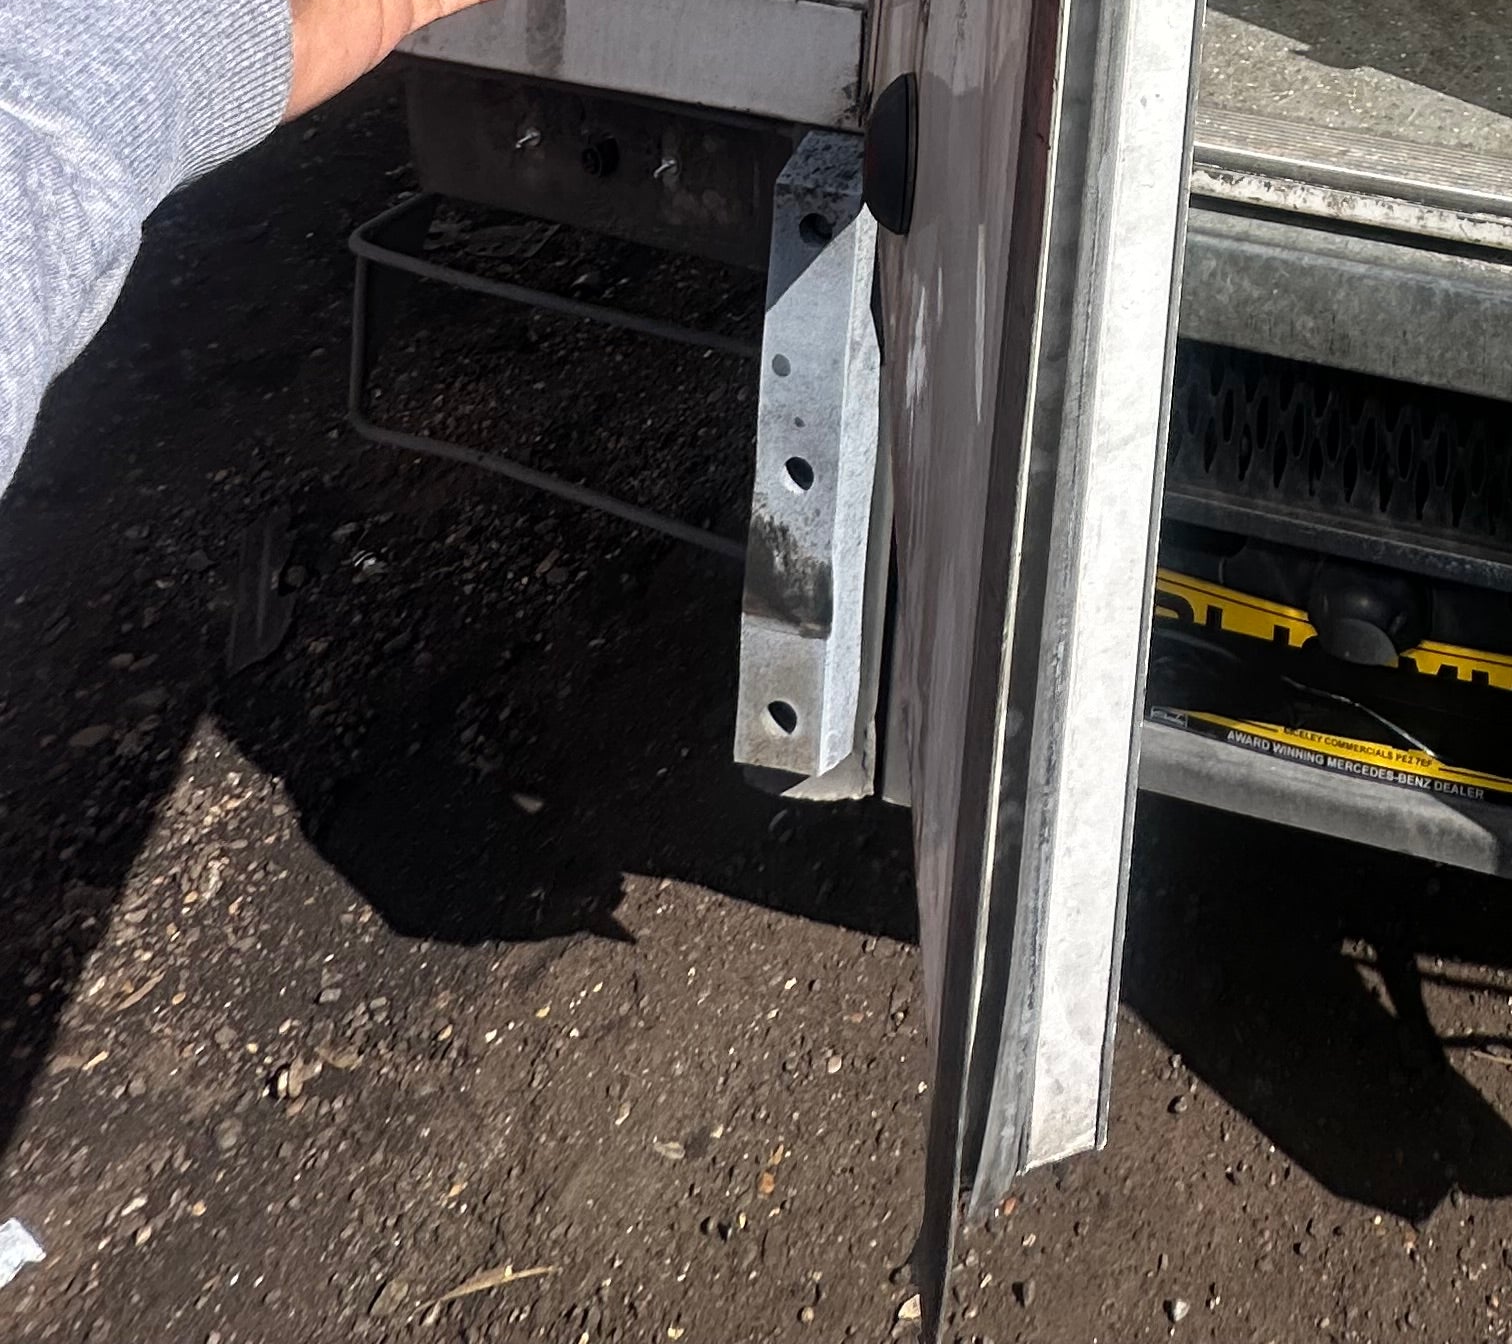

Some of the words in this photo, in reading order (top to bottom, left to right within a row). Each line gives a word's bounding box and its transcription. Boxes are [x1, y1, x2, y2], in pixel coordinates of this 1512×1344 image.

[1227, 729, 1270, 752] AWARD
[1272, 741, 1325, 766] WINNING
[1327, 757, 1431, 790] MERCEDES-BENZ
[1434, 781, 1484, 801] DEALER
[1324, 735, 1393, 761] COMMERCIALS
